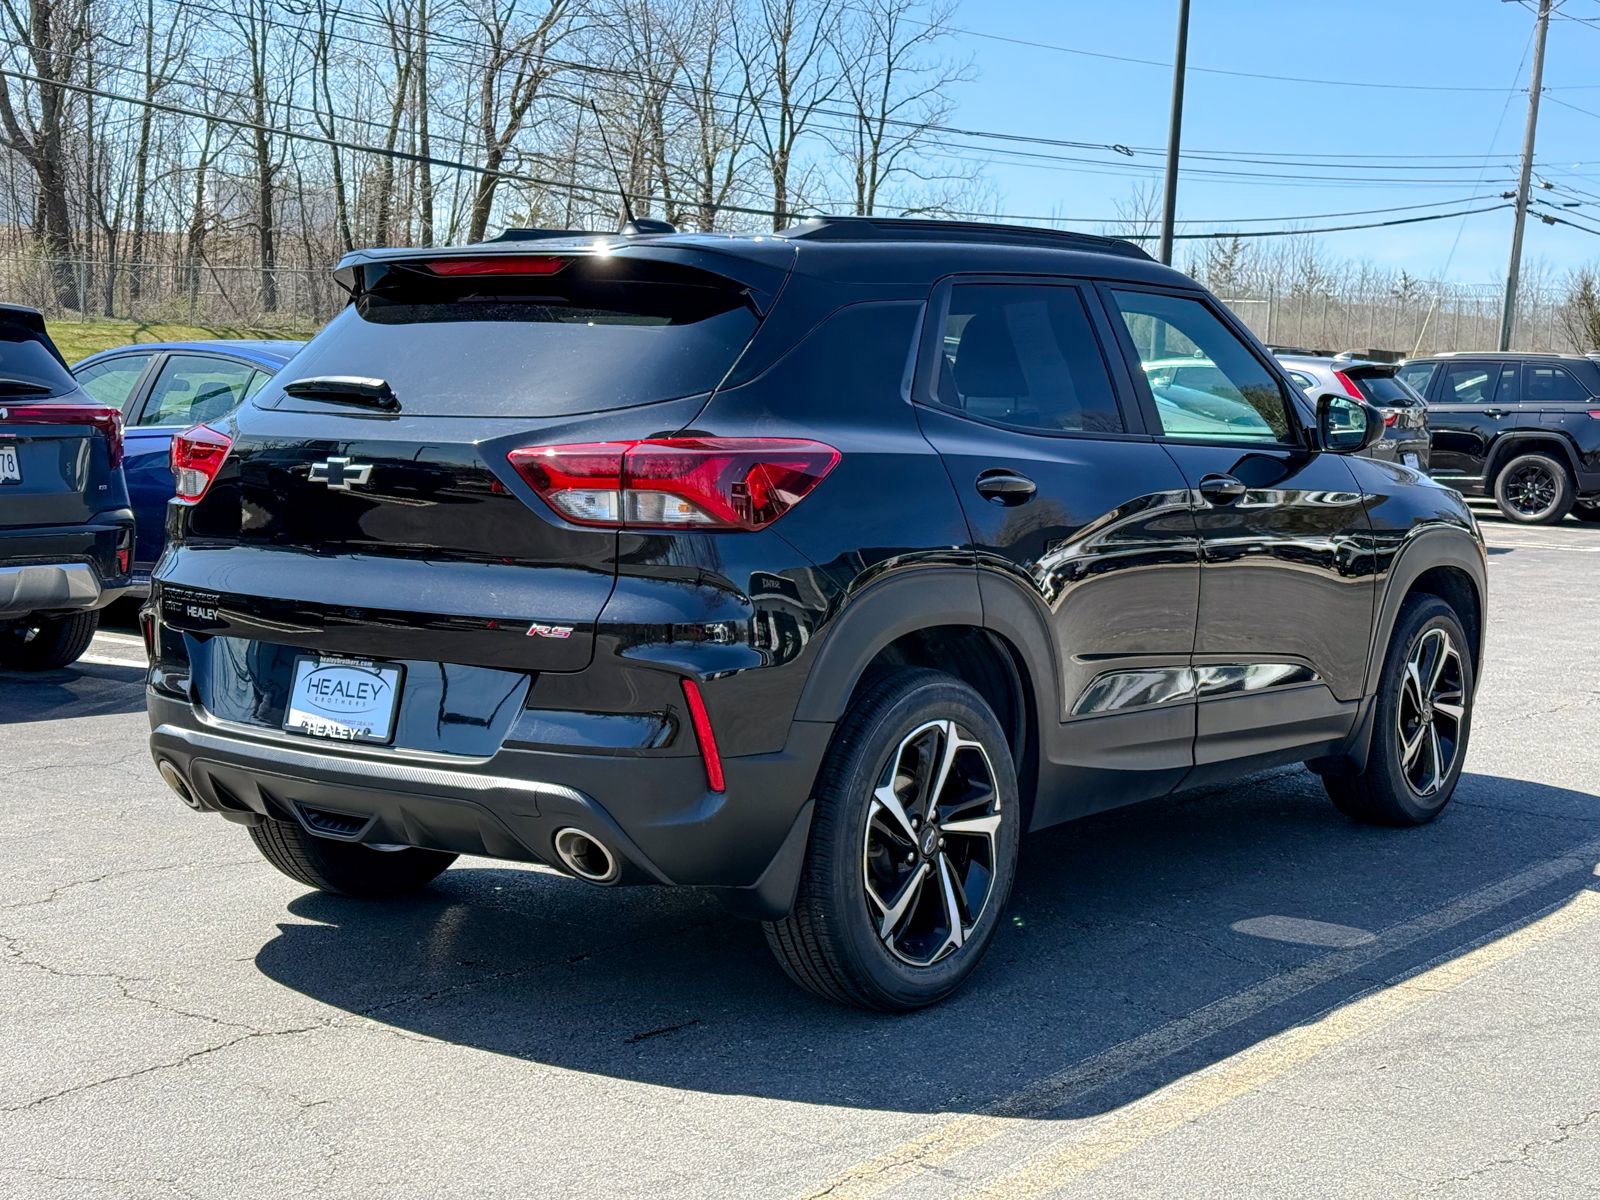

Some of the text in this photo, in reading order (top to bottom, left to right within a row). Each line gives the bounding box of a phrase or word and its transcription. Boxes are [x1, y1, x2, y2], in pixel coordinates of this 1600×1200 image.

[0, 454, 15, 473] 78
[187, 605, 219, 620] HEALEY
[526, 623, 574, 638] RS
[307, 677, 384, 701] HEALEY
[314, 697, 366, 707] BROTHERS
[307, 722, 358, 740] HEALEY
